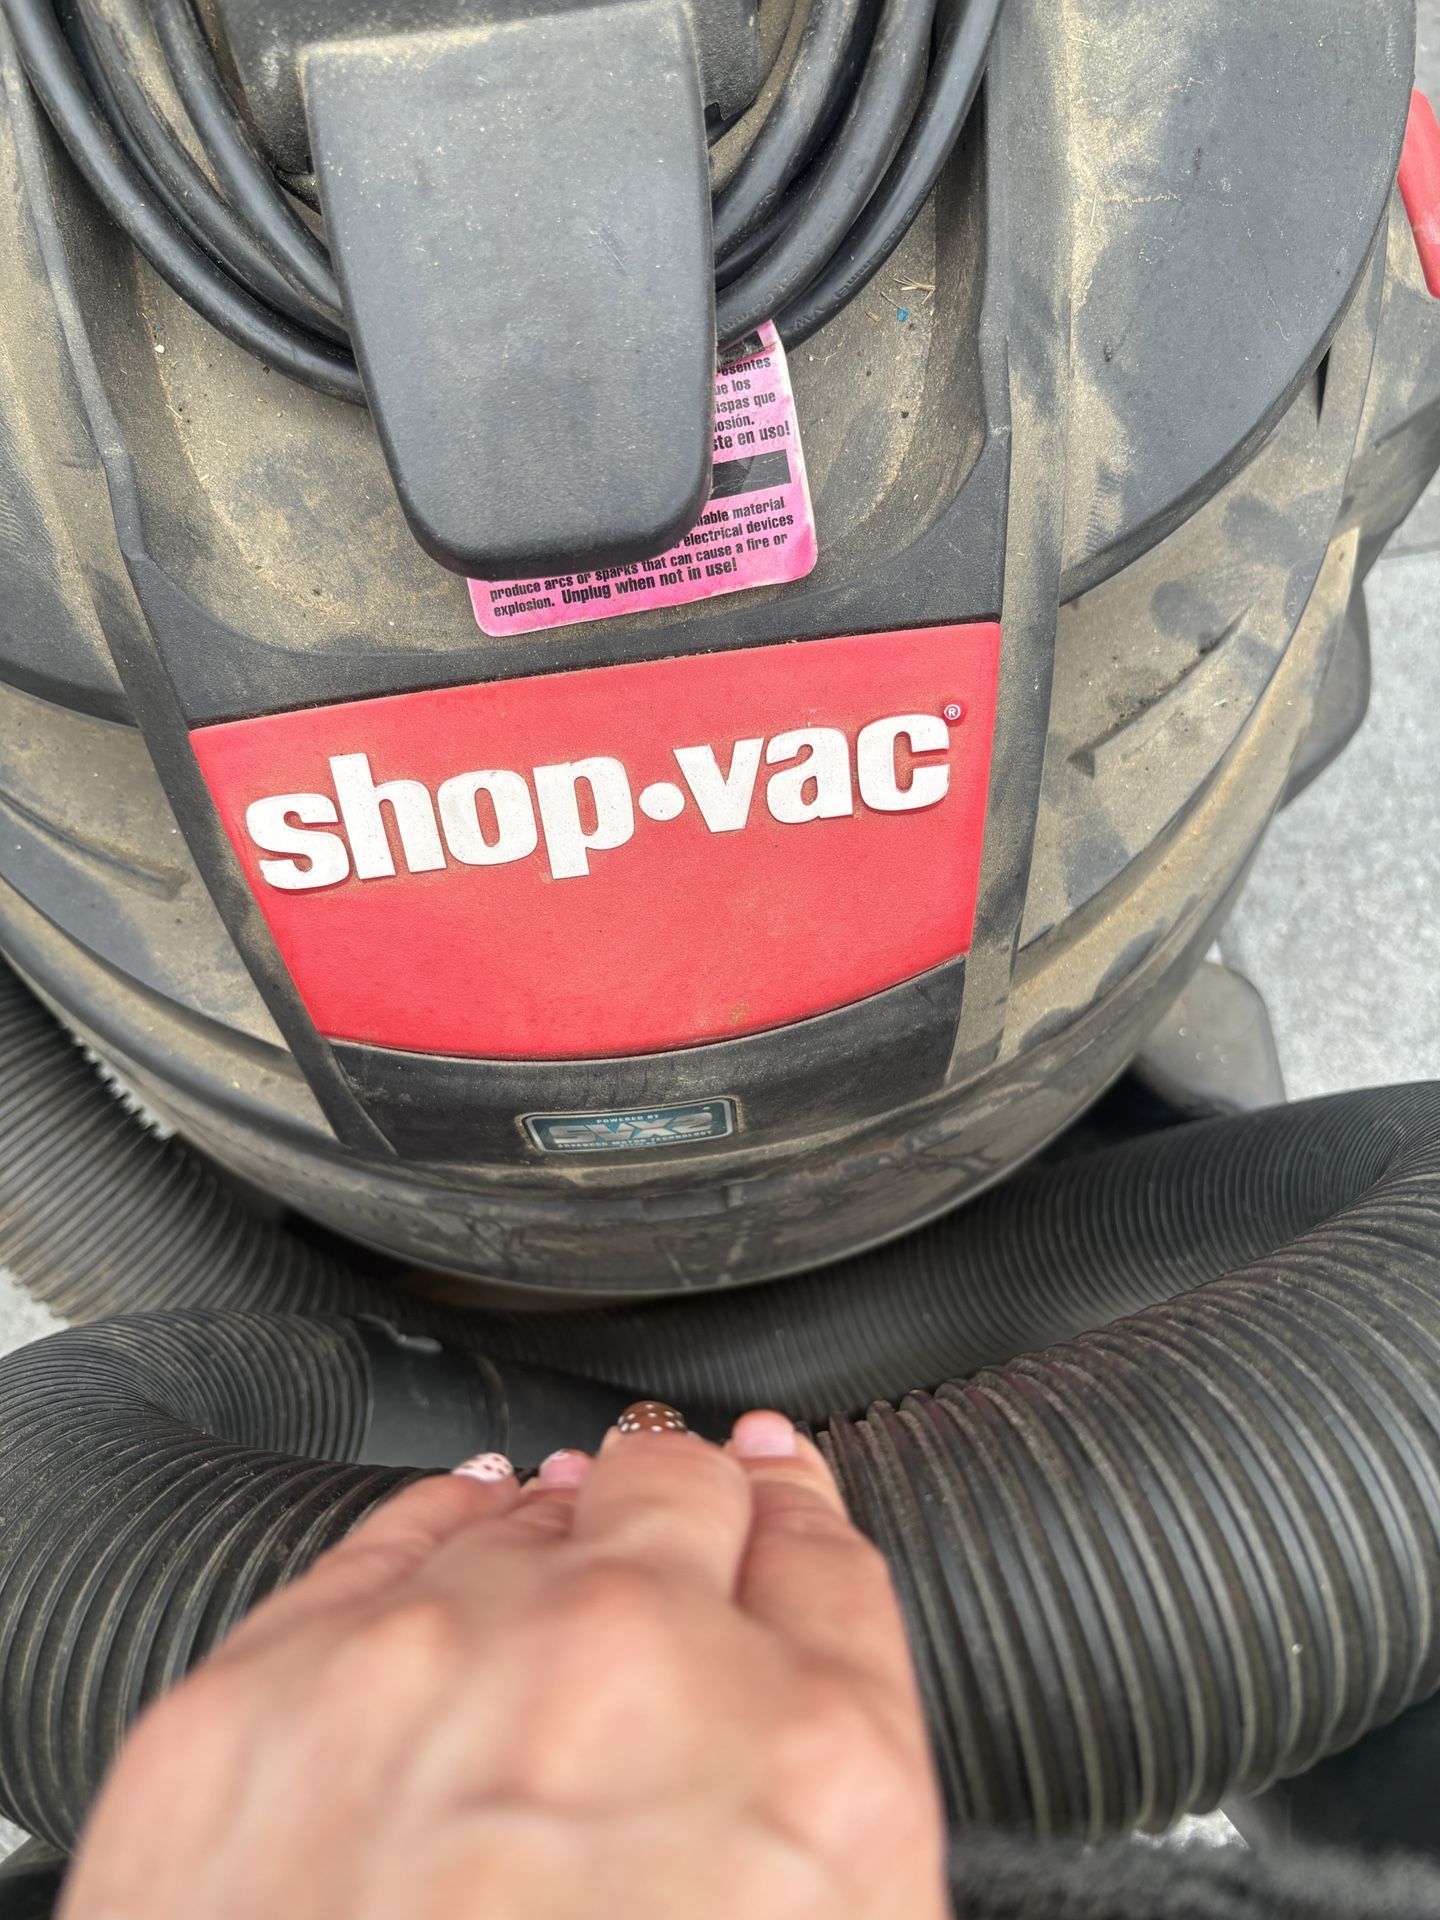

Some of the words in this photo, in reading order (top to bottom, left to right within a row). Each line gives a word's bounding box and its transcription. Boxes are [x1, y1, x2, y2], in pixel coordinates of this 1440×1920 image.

[731, 379, 751, 392] los
[753, 392, 776, 407] que
[737, 430, 755, 445] en
[759, 420, 791, 441] uso!
[732, 496, 785, 519] material
[683, 523, 743, 547] electrical
[746, 514, 794, 534] devices
[489, 581, 541, 602] produce
[544, 576, 573, 590] arcs
[577, 572, 591, 585] or
[595, 563, 639, 582] sparks
[642, 557, 667, 572] that
[670, 553, 692, 567] can
[696, 544, 732, 562] cause
[735, 542, 743, 554] a
[746, 537, 770, 552] fire
[773, 533, 788, 546] or
[493, 596, 555, 617] explosion.
[561, 583, 611, 604] Unplug
[615, 575, 656, 594] when
[659, 568, 684, 587] not
[687, 566, 702, 581] in
[705, 557, 738, 577] use!
